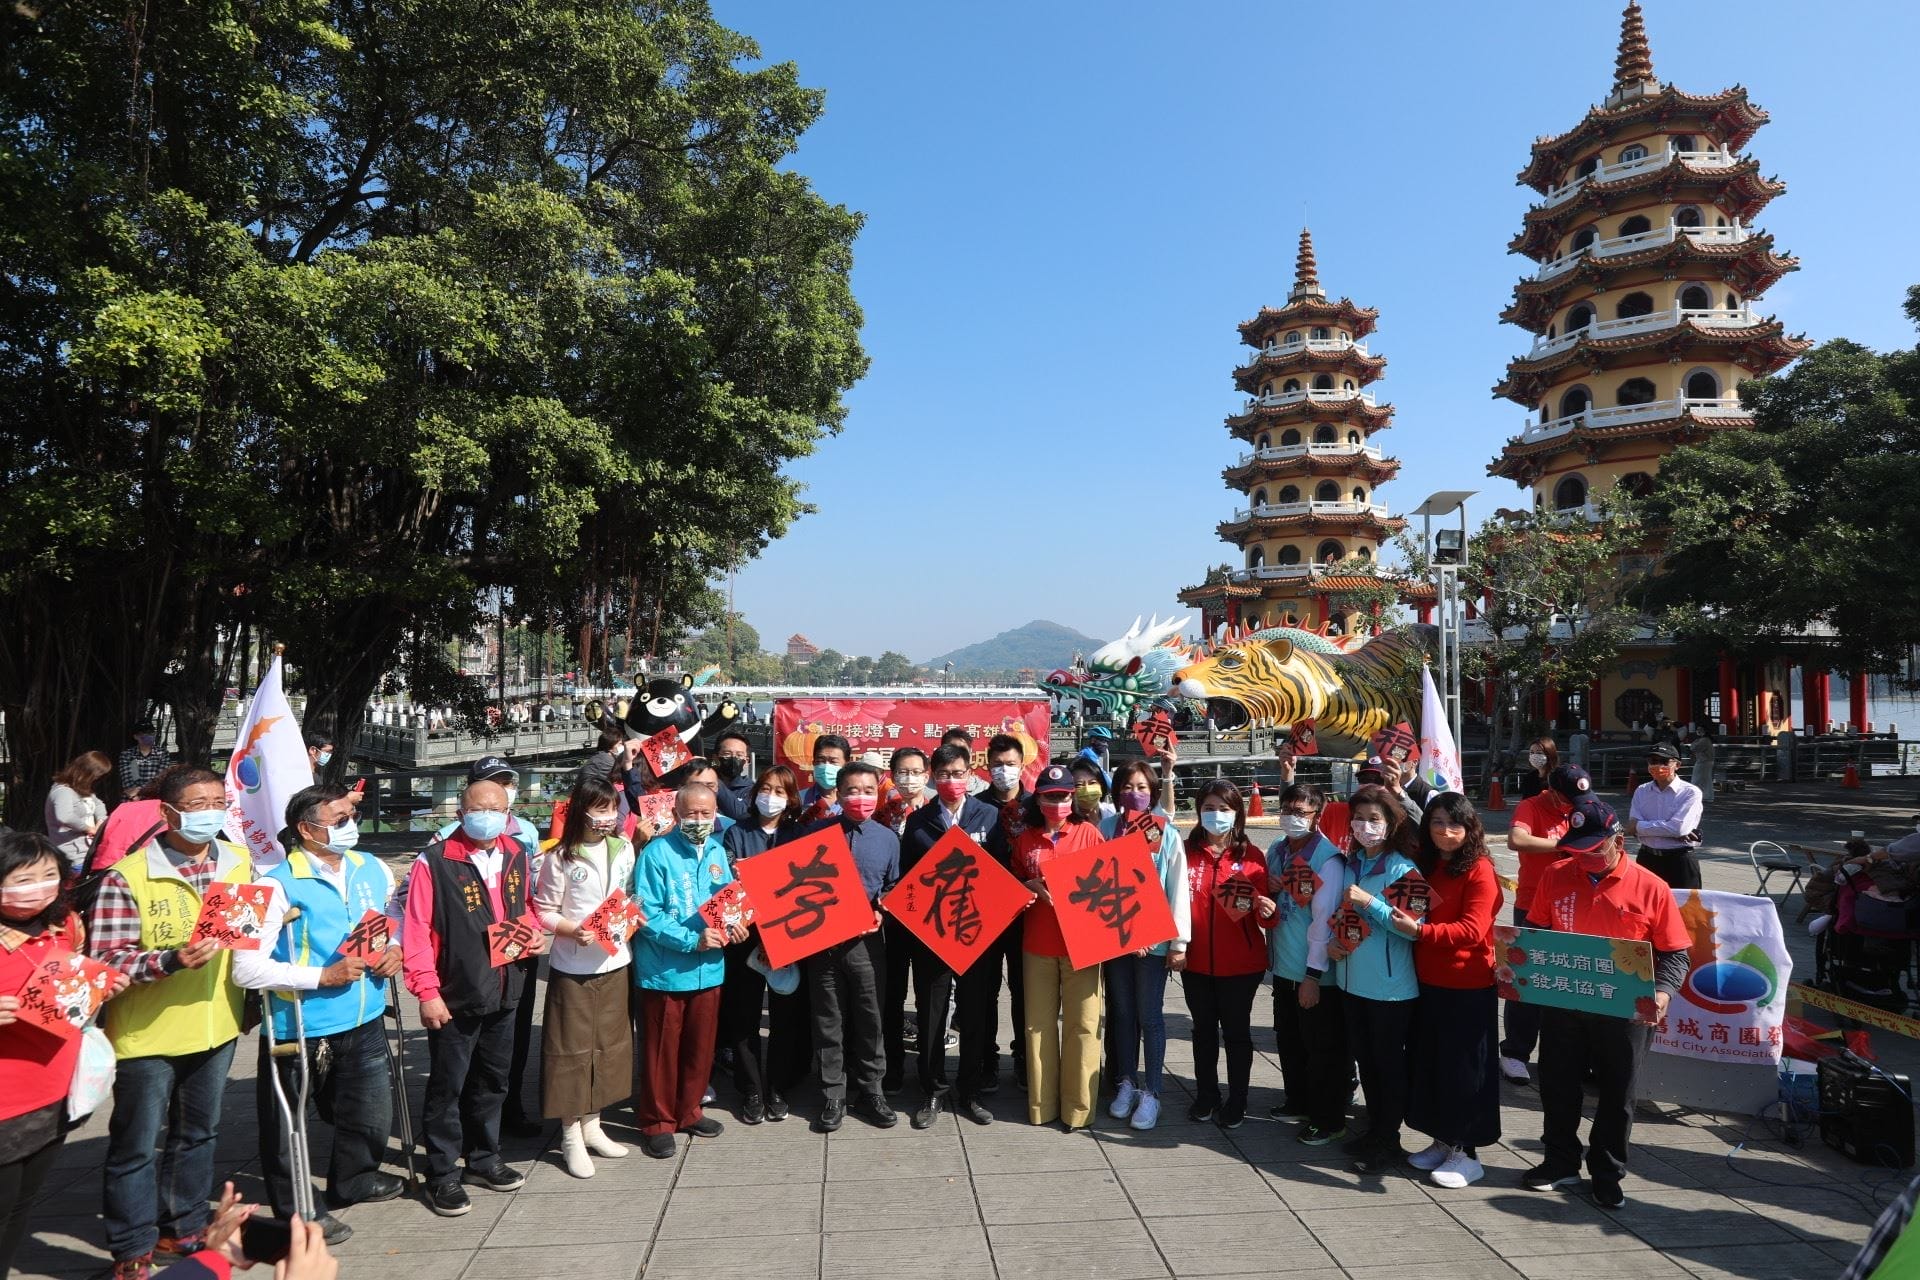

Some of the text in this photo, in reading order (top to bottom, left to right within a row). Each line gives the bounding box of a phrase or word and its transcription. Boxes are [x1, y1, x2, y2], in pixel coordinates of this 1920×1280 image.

[1375, 729, 1416, 763] 福
[1218, 877, 1256, 914] 福
[1284, 864, 1315, 899] 福
[1388, 877, 1430, 915] 福
[147, 898, 176, 950] 胡俊
[346, 914, 390, 956] 福
[492, 918, 533, 960] 福
[1332, 908, 1364, 945] 福
[1529, 948, 1615, 975] 舊城商圈
[1529, 972, 1618, 999] 發展協會
[1682, 1041, 1708, 1054] City
